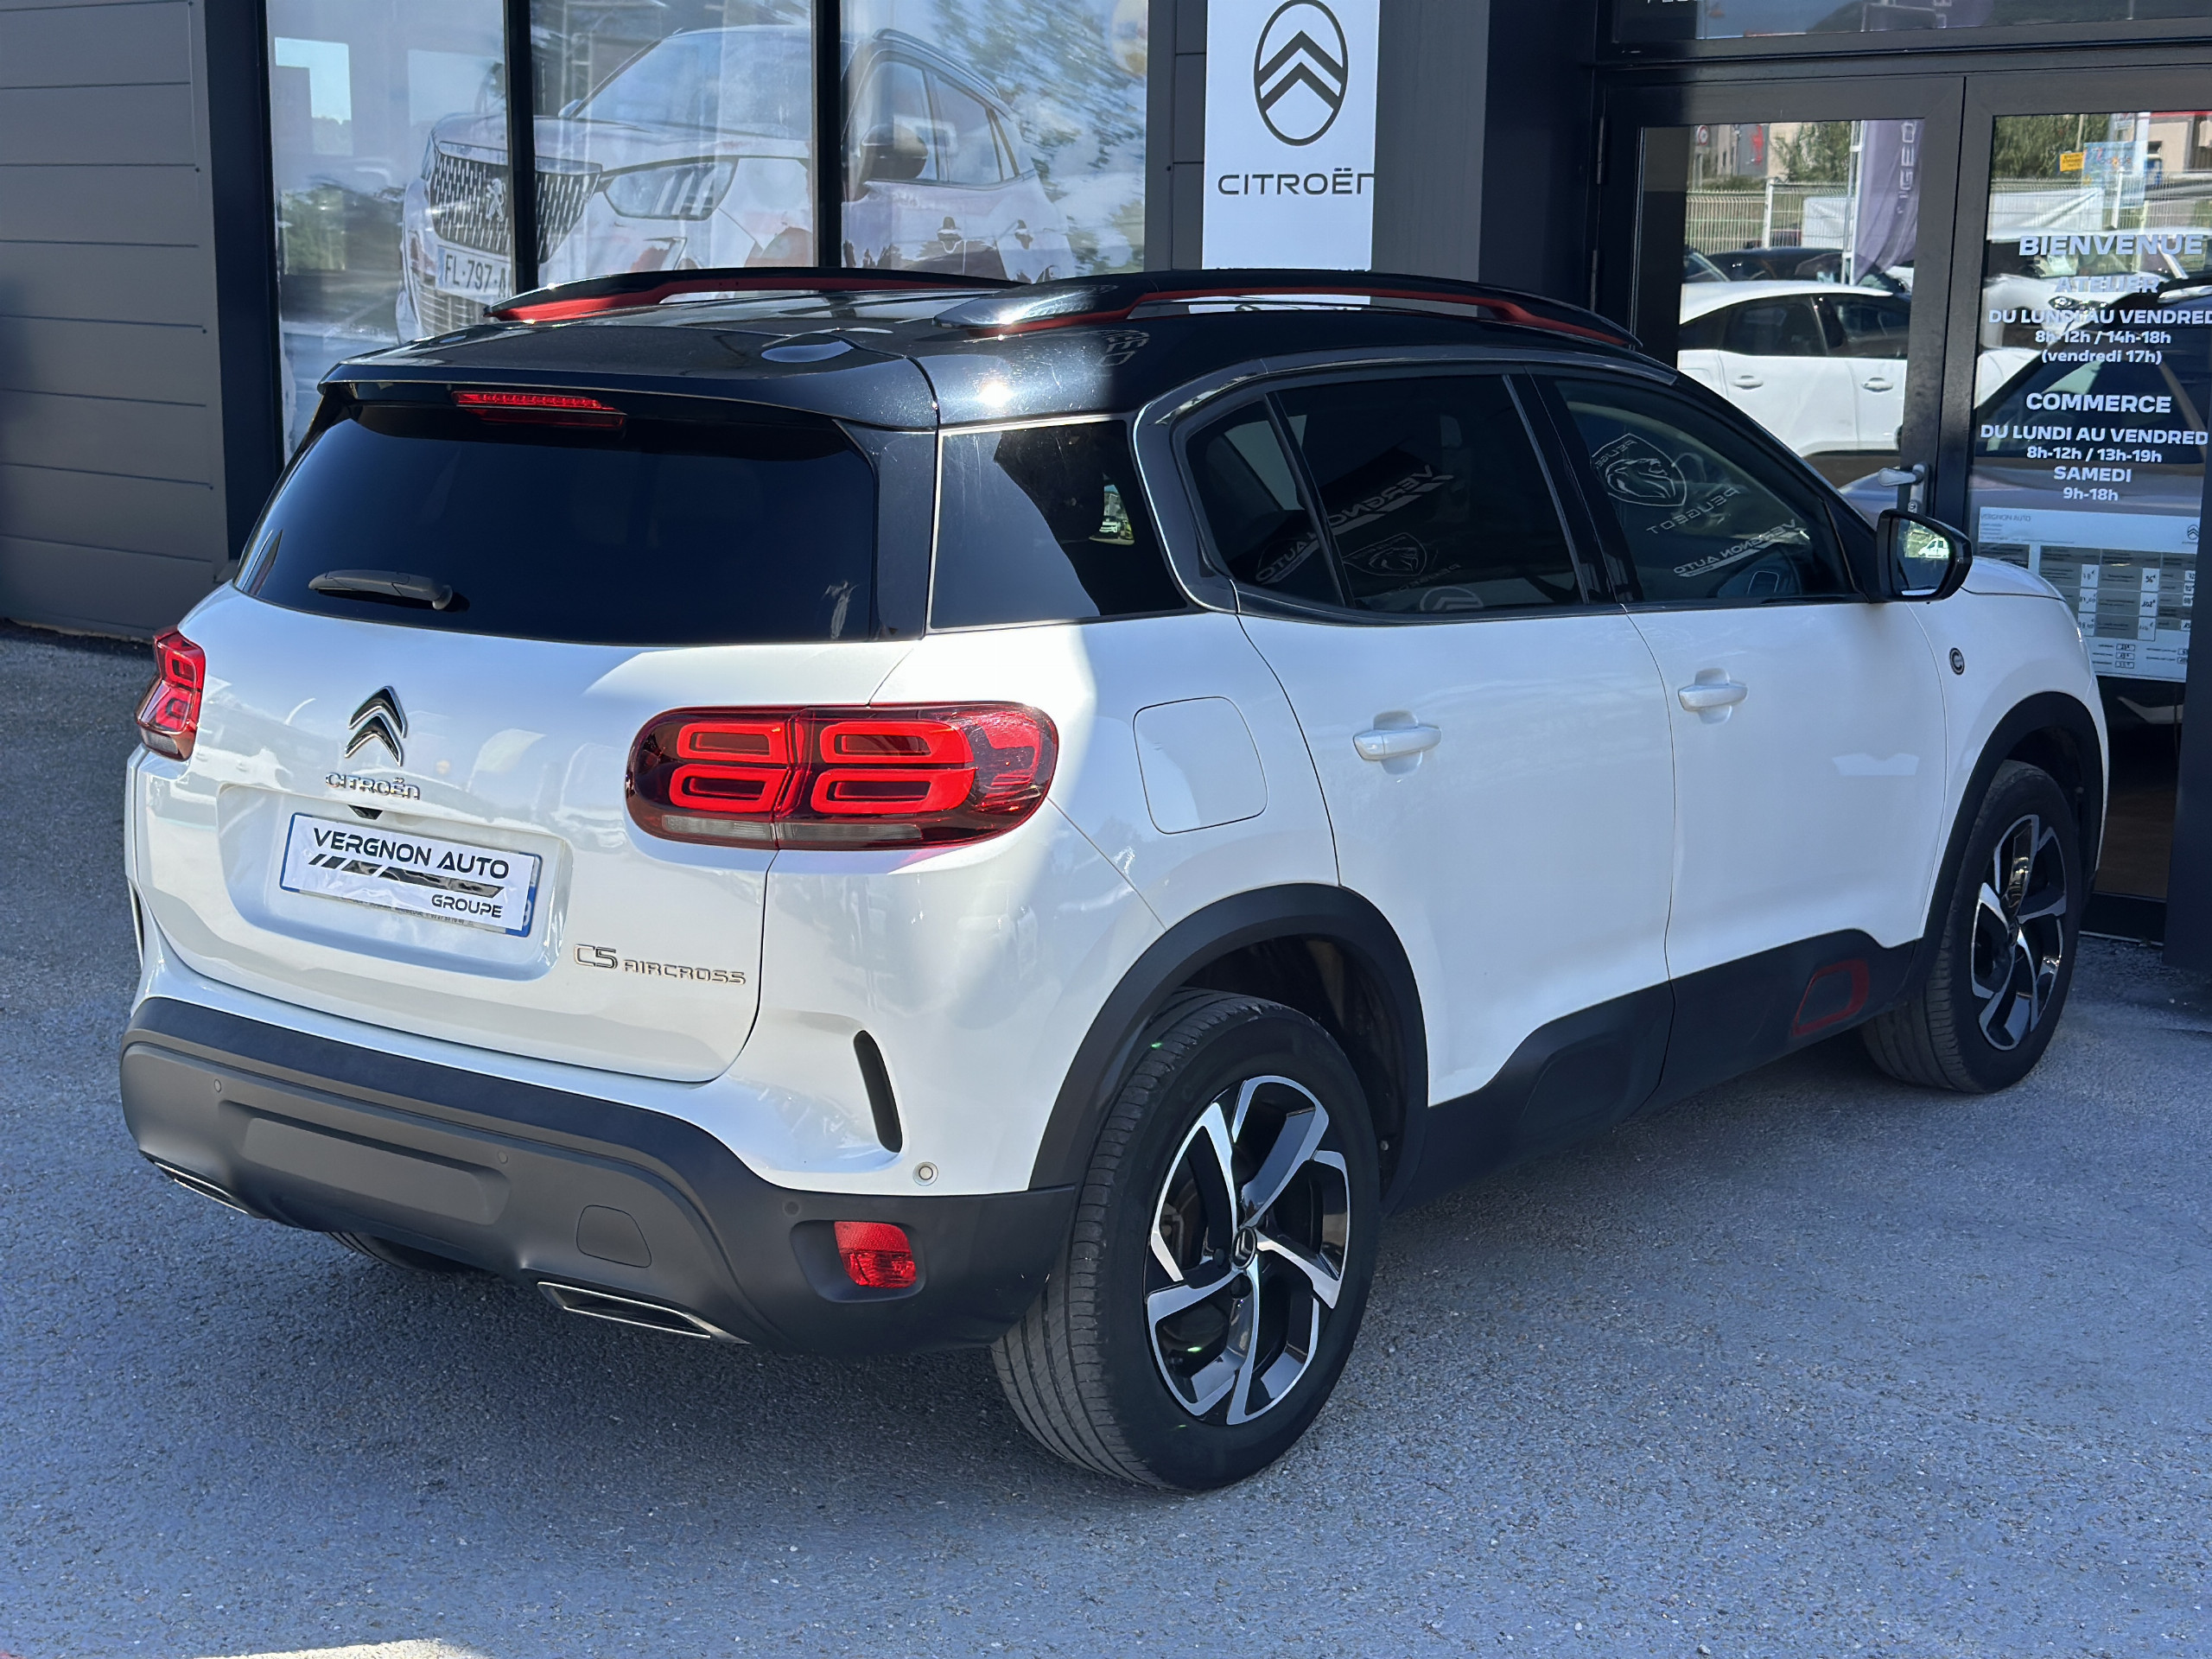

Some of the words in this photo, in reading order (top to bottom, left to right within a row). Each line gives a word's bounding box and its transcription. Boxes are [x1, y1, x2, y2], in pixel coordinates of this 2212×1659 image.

[2019, 234, 2202, 256] BIENVENUE
[2055, 276, 2161, 294] ATELIER
[1988, 309, 2017, 324] DU
[2020, 309, 2082, 324] LUNDI
[2084, 309, 2115, 324] AU
[2035, 330, 2091, 343] 8h-12h
[2107, 330, 2171, 344] 14h-18h
[2041, 349, 2122, 363] (vendredi
[2126, 350, 2162, 365] 17h)
[2026, 392, 2171, 413] COMMERCE
[1980, 424, 2009, 439] DU
[2012, 425, 2073, 441] LUNDI
[2075, 427, 2106, 442] AU
[2026, 446, 2082, 460] 8h-12h
[2085, 448, 2094, 461] /
[2097, 448, 2163, 463] 13h-19h
[2053, 466, 2132, 482] SAMEDI
[2063, 486, 2119, 501] 9h-18h
[325, 772, 420, 801] CITROËN
[313, 827, 430, 868] VERGNON
[436, 850, 510, 879] AUTO
[431, 893, 504, 918] GROUPE
[574, 943, 620, 969] C5
[622, 959, 747, 986] AIRCROSS
